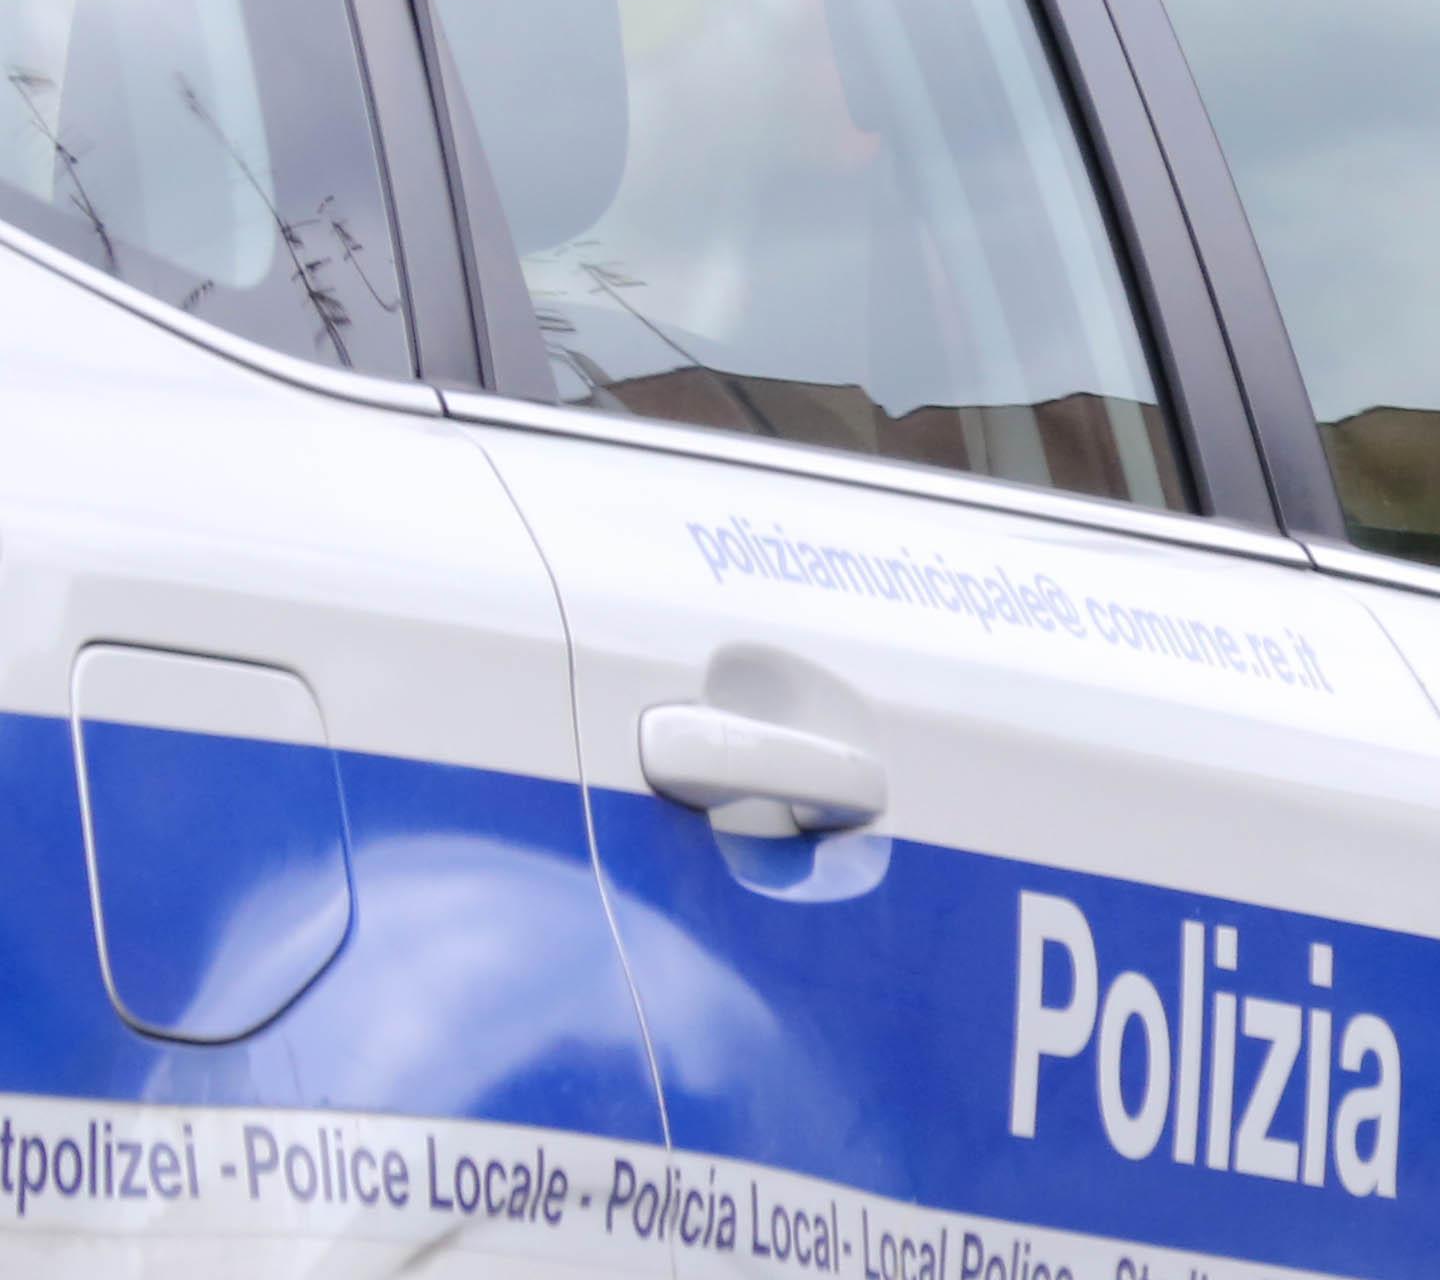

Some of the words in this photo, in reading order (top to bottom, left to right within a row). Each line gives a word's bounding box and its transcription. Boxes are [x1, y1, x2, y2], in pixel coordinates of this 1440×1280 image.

[1009, 888, 1401, 1200] Polizia
[243, 1122, 410, 1208] Police
[428, 1135, 567, 1227] Locale
